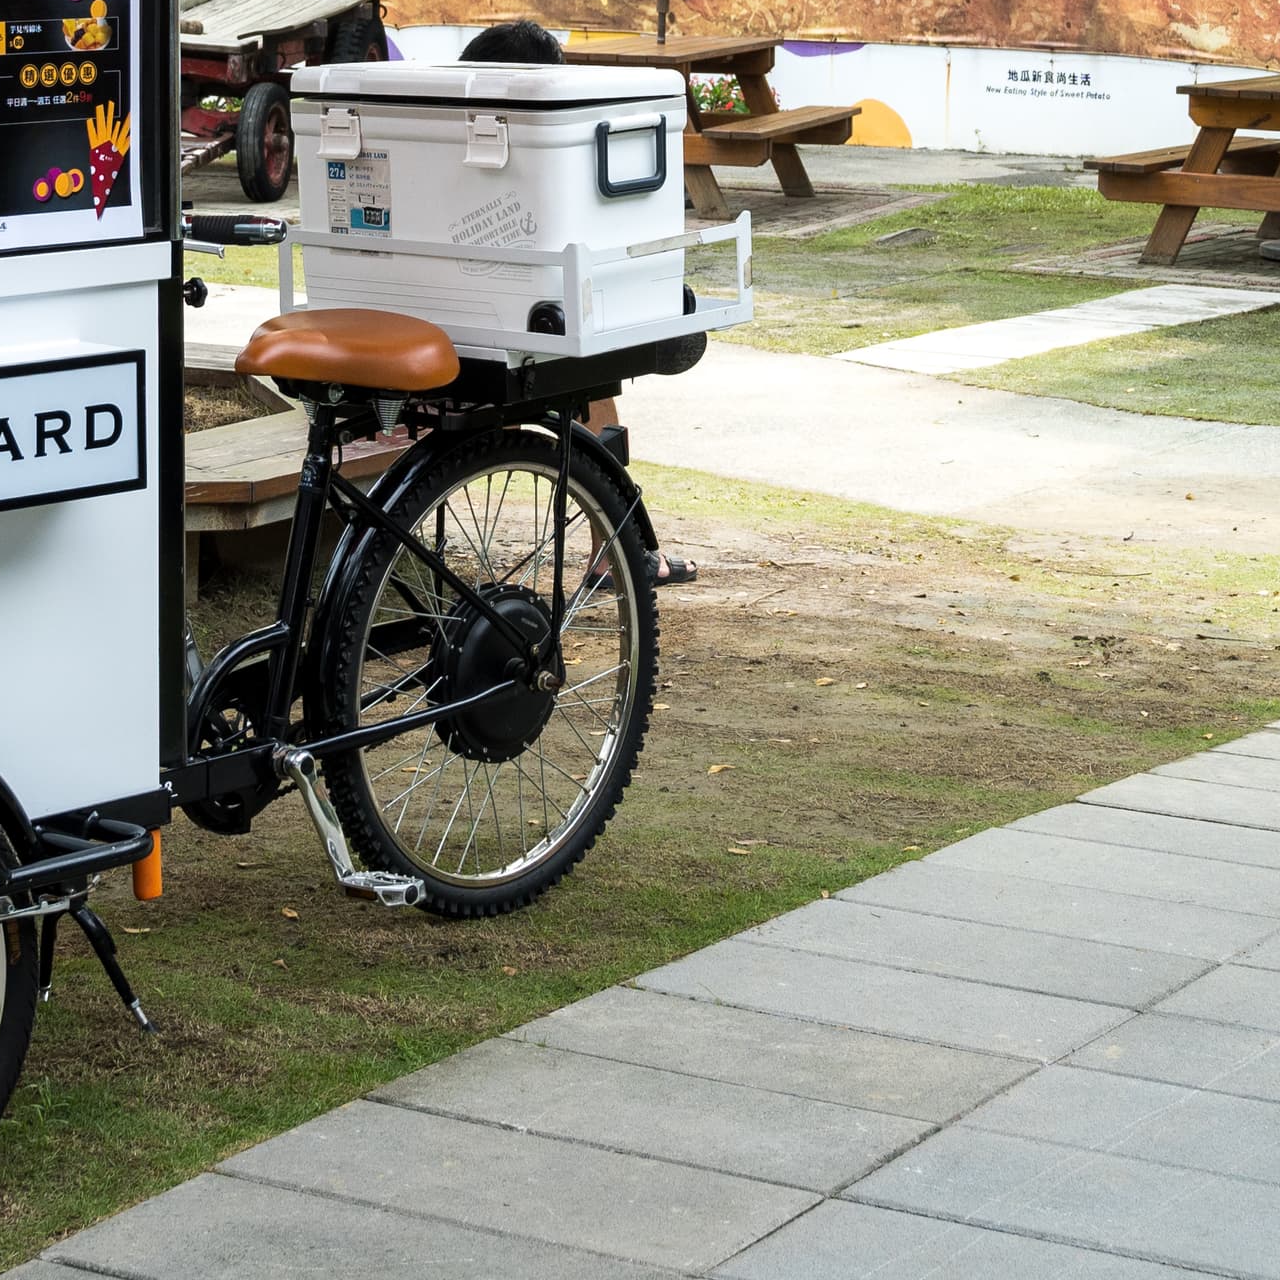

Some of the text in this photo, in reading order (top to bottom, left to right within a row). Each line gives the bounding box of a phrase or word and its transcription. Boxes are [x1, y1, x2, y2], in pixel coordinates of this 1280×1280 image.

[1007, 69, 1091, 86] 地瓜新食尚生活
[985, 86, 1001, 94] New
[1003, 86, 1027, 96] Eating
[1030, 88, 1047, 97] Style
[1060, 90, 1084, 98] Sweet
[1086, 91, 1111, 100] Potato
[461, 197, 502, 225] ETERNALLY
[451, 201, 521, 244] HOLIDAY LAND
